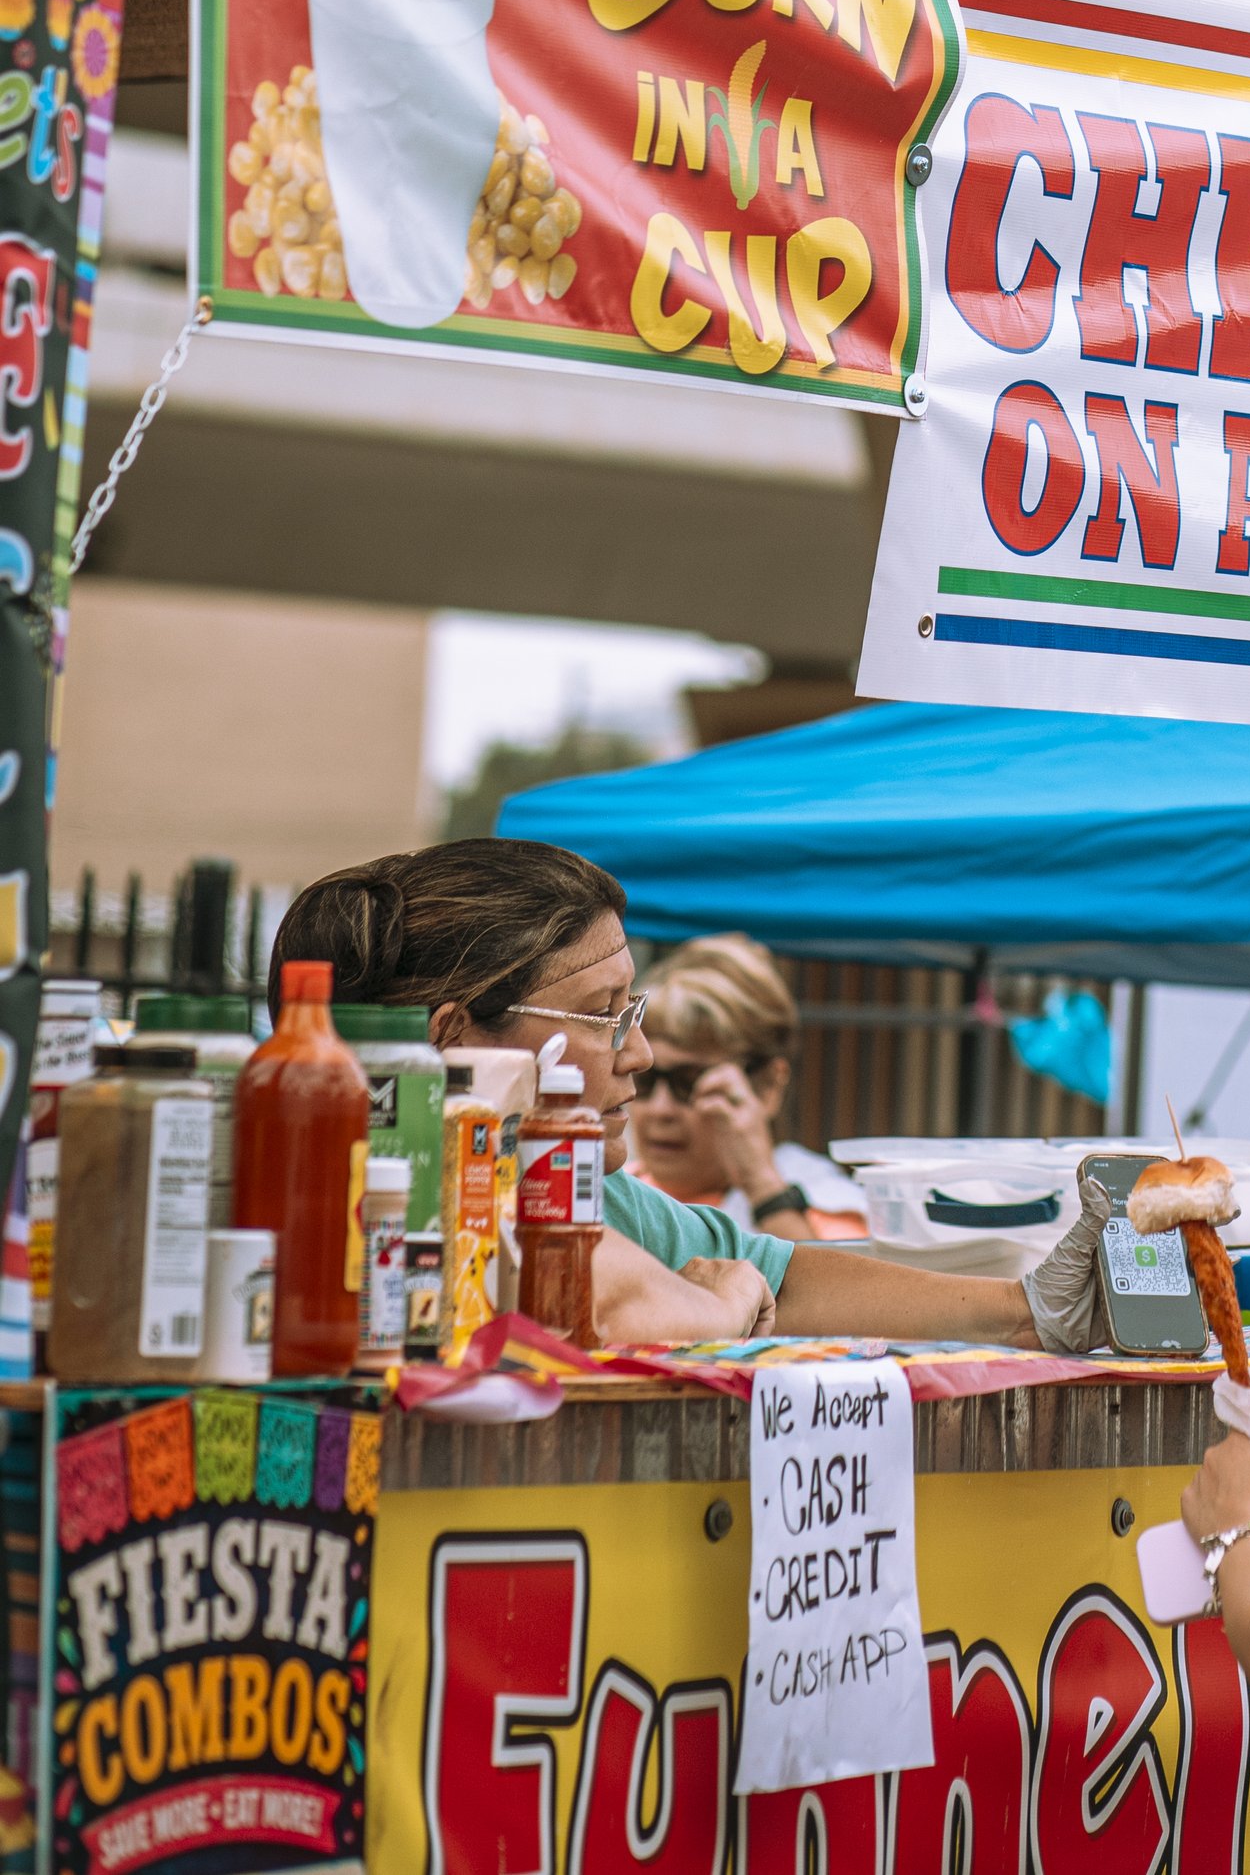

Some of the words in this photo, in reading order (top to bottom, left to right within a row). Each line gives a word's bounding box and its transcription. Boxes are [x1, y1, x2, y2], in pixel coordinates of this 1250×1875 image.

[776, 99, 824, 196] A
[630, 212, 873, 374] CUP
[982, 380, 1180, 569] ON
[760, 1384, 795, 1441] We
[812, 1376, 889, 1430] Accept
[780, 1454, 869, 1535] CASH
[68, 1518, 351, 1692] FIESTA
[764, 1529, 897, 1621] CREDIT
[76, 1654, 350, 1806] COMBOS
[97, 1811, 152, 1869] SAVE
[152, 1792, 211, 1844] MORE
[224, 1788, 260, 1829] EAT
